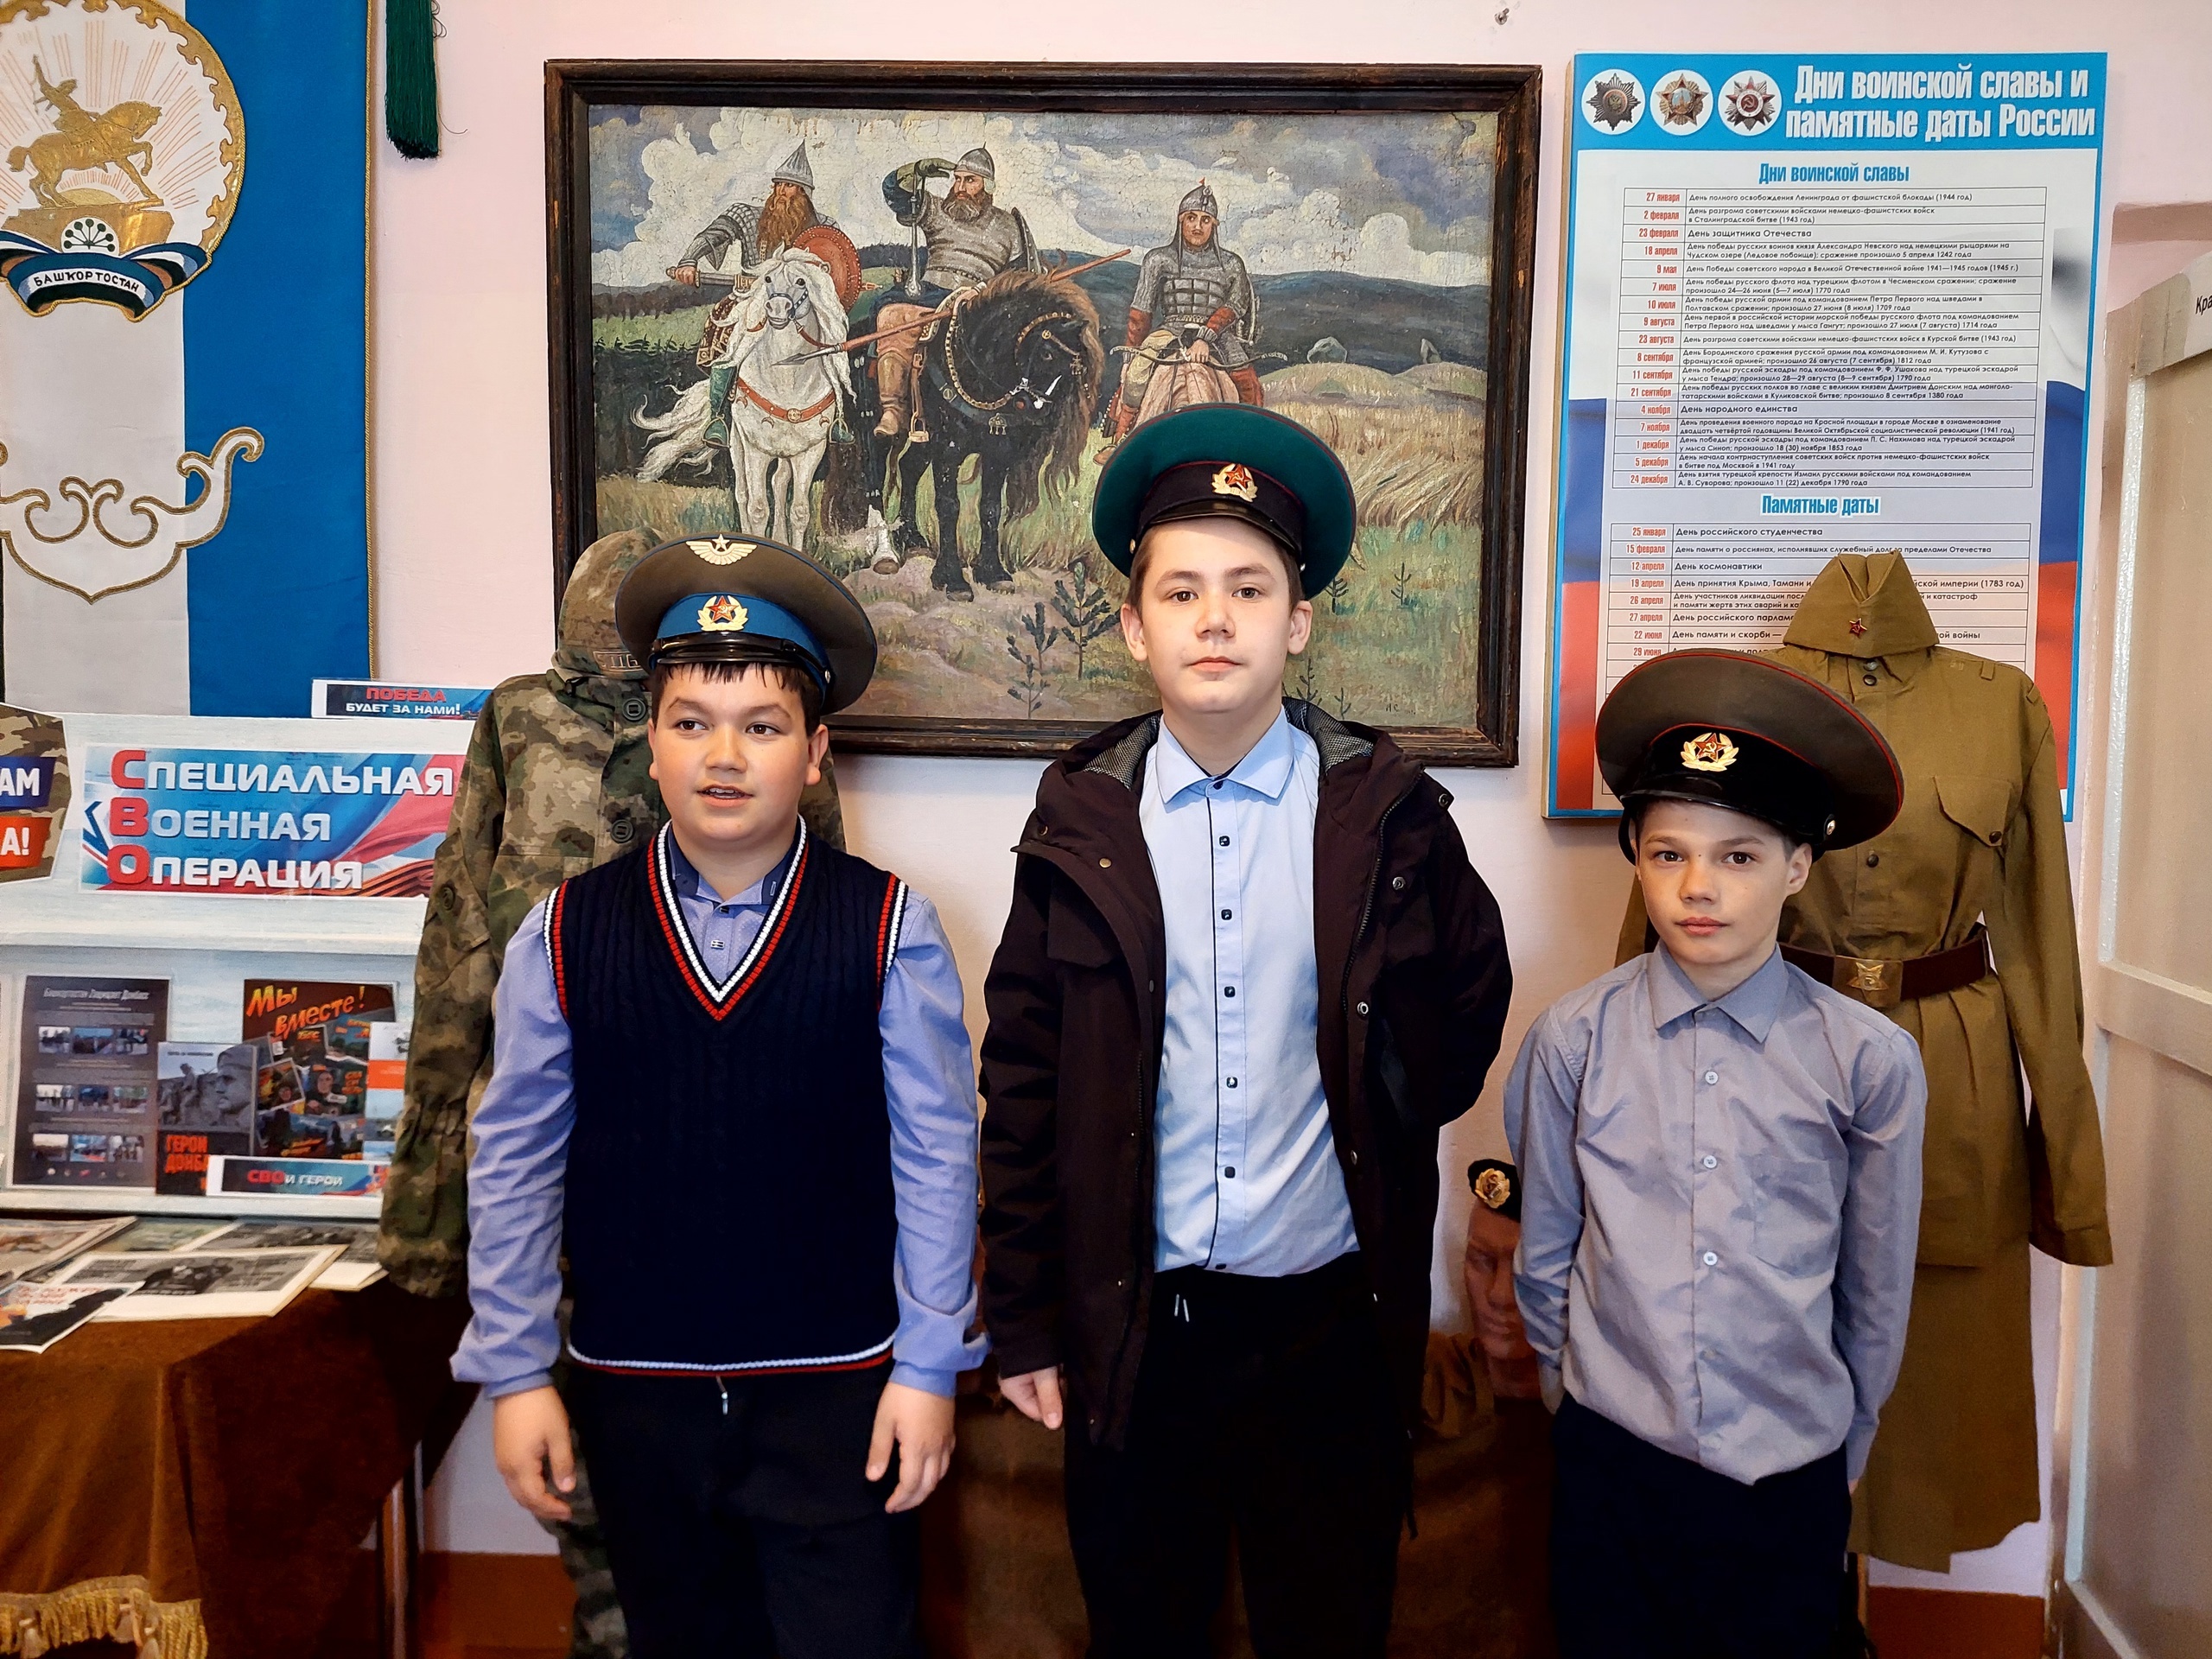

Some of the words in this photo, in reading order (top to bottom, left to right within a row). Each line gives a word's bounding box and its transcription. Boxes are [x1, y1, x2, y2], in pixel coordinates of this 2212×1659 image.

[1795, 66, 1844, 104] Дни
[1852, 63, 1972, 99] воинской
[1980, 71, 2063, 99] славы
[2070, 70, 2088, 97] и
[1786, 111, 1918, 137] памятные
[1925, 110, 1991, 142] даты
[1999, 104, 2095, 137] России
[1758, 163, 1786, 184] Дни
[1791, 162, 1859, 181] воинской
[1864, 166, 1909, 181] славы
[1656, 194, 1680, 203] января
[1650, 211, 1679, 221] февраля
[1649, 228, 1679, 238] февраля
[1655, 248, 1677, 257] апреля
[2010, 264, 2018, 272] г.)
[1650, 319, 1675, 327] августа
[1649, 336, 1674, 345] августа
[1643, 352, 1674, 363] сентября
[1643, 369, 1673, 380] сентября
[1642, 387, 1671, 397] сентября
[1648, 404, 1670, 415] ноября
[1647, 422, 1669, 433] ноября
[1642, 439, 1669, 450] декабря
[1642, 456, 1669, 467] декабря
[1641, 474, 1668, 485] декабря
[1763, 495, 1838, 513] Памятные
[1841, 499, 1878, 516] даты
[1643, 529, 1666, 537] января
[1700, 528, 1758, 537] российского
[1637, 544, 1665, 554] февраля
[1830, 546, 1874, 555] служебный
[1980, 580, 2004, 588] (1783
[2005, 580, 2024, 588] год)
[1641, 597, 1663, 606] апреля
[1640, 614, 1662, 623] апреля
[1697, 613, 1754, 622] российского
[1738, 631, 1770, 639] скорби
[365, 687, 446, 702] ПОБЕДА
[346, 702, 389, 713] БУДЕТ
[392, 704, 411, 714] ЗА
[415, 703, 461, 715] НАМИ!
[111, 749, 454, 797] СПЕЦИАЛЬНАЯ
[109, 796, 331, 842] ВОЕННАЯ
[106, 843, 362, 890] ОПЕРАЦИЯ
[246, 985, 297, 1017] Мы
[167, 1135, 207, 1154] ГЕРОИ
